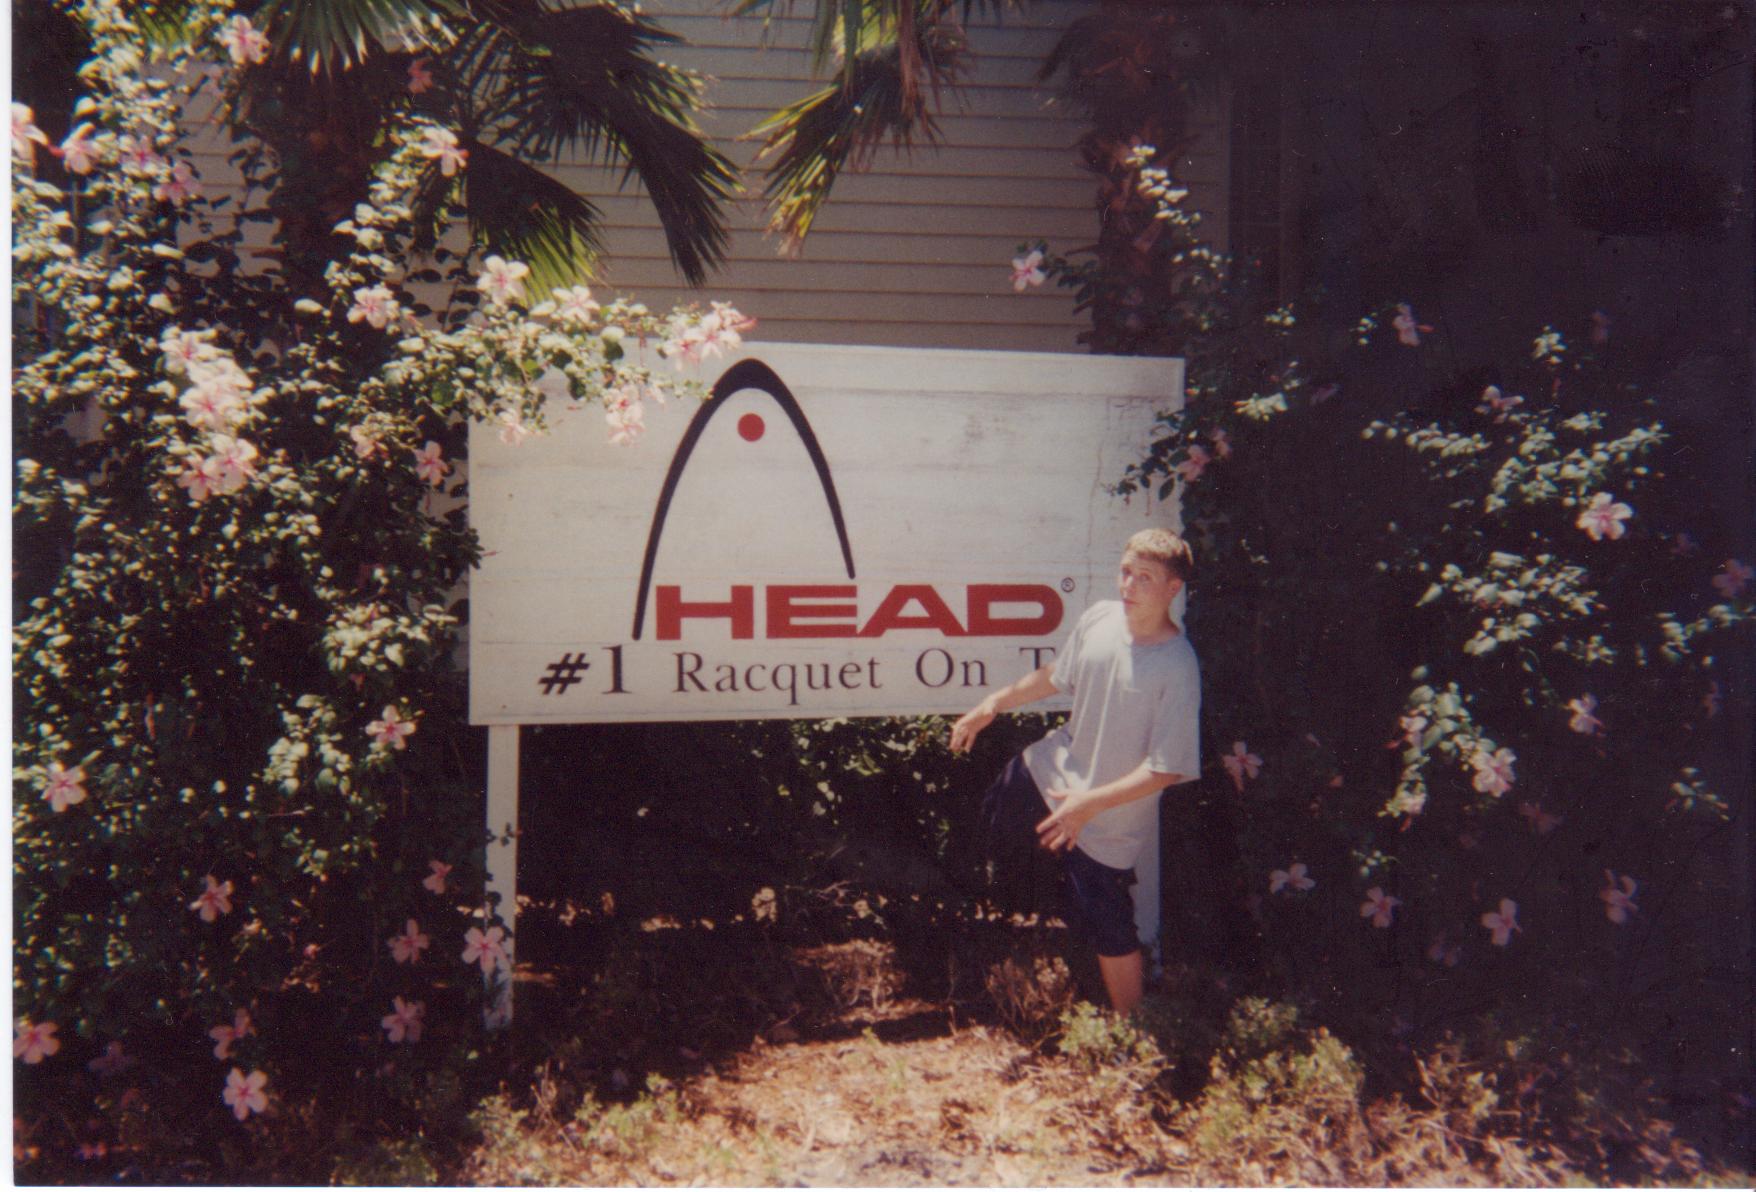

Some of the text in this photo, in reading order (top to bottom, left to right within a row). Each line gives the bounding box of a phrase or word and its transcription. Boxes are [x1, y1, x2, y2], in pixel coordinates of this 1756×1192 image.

[537, 644, 632, 695] #1
[672, 651, 882, 706] Racquet
[915, 647, 989, 688] On
